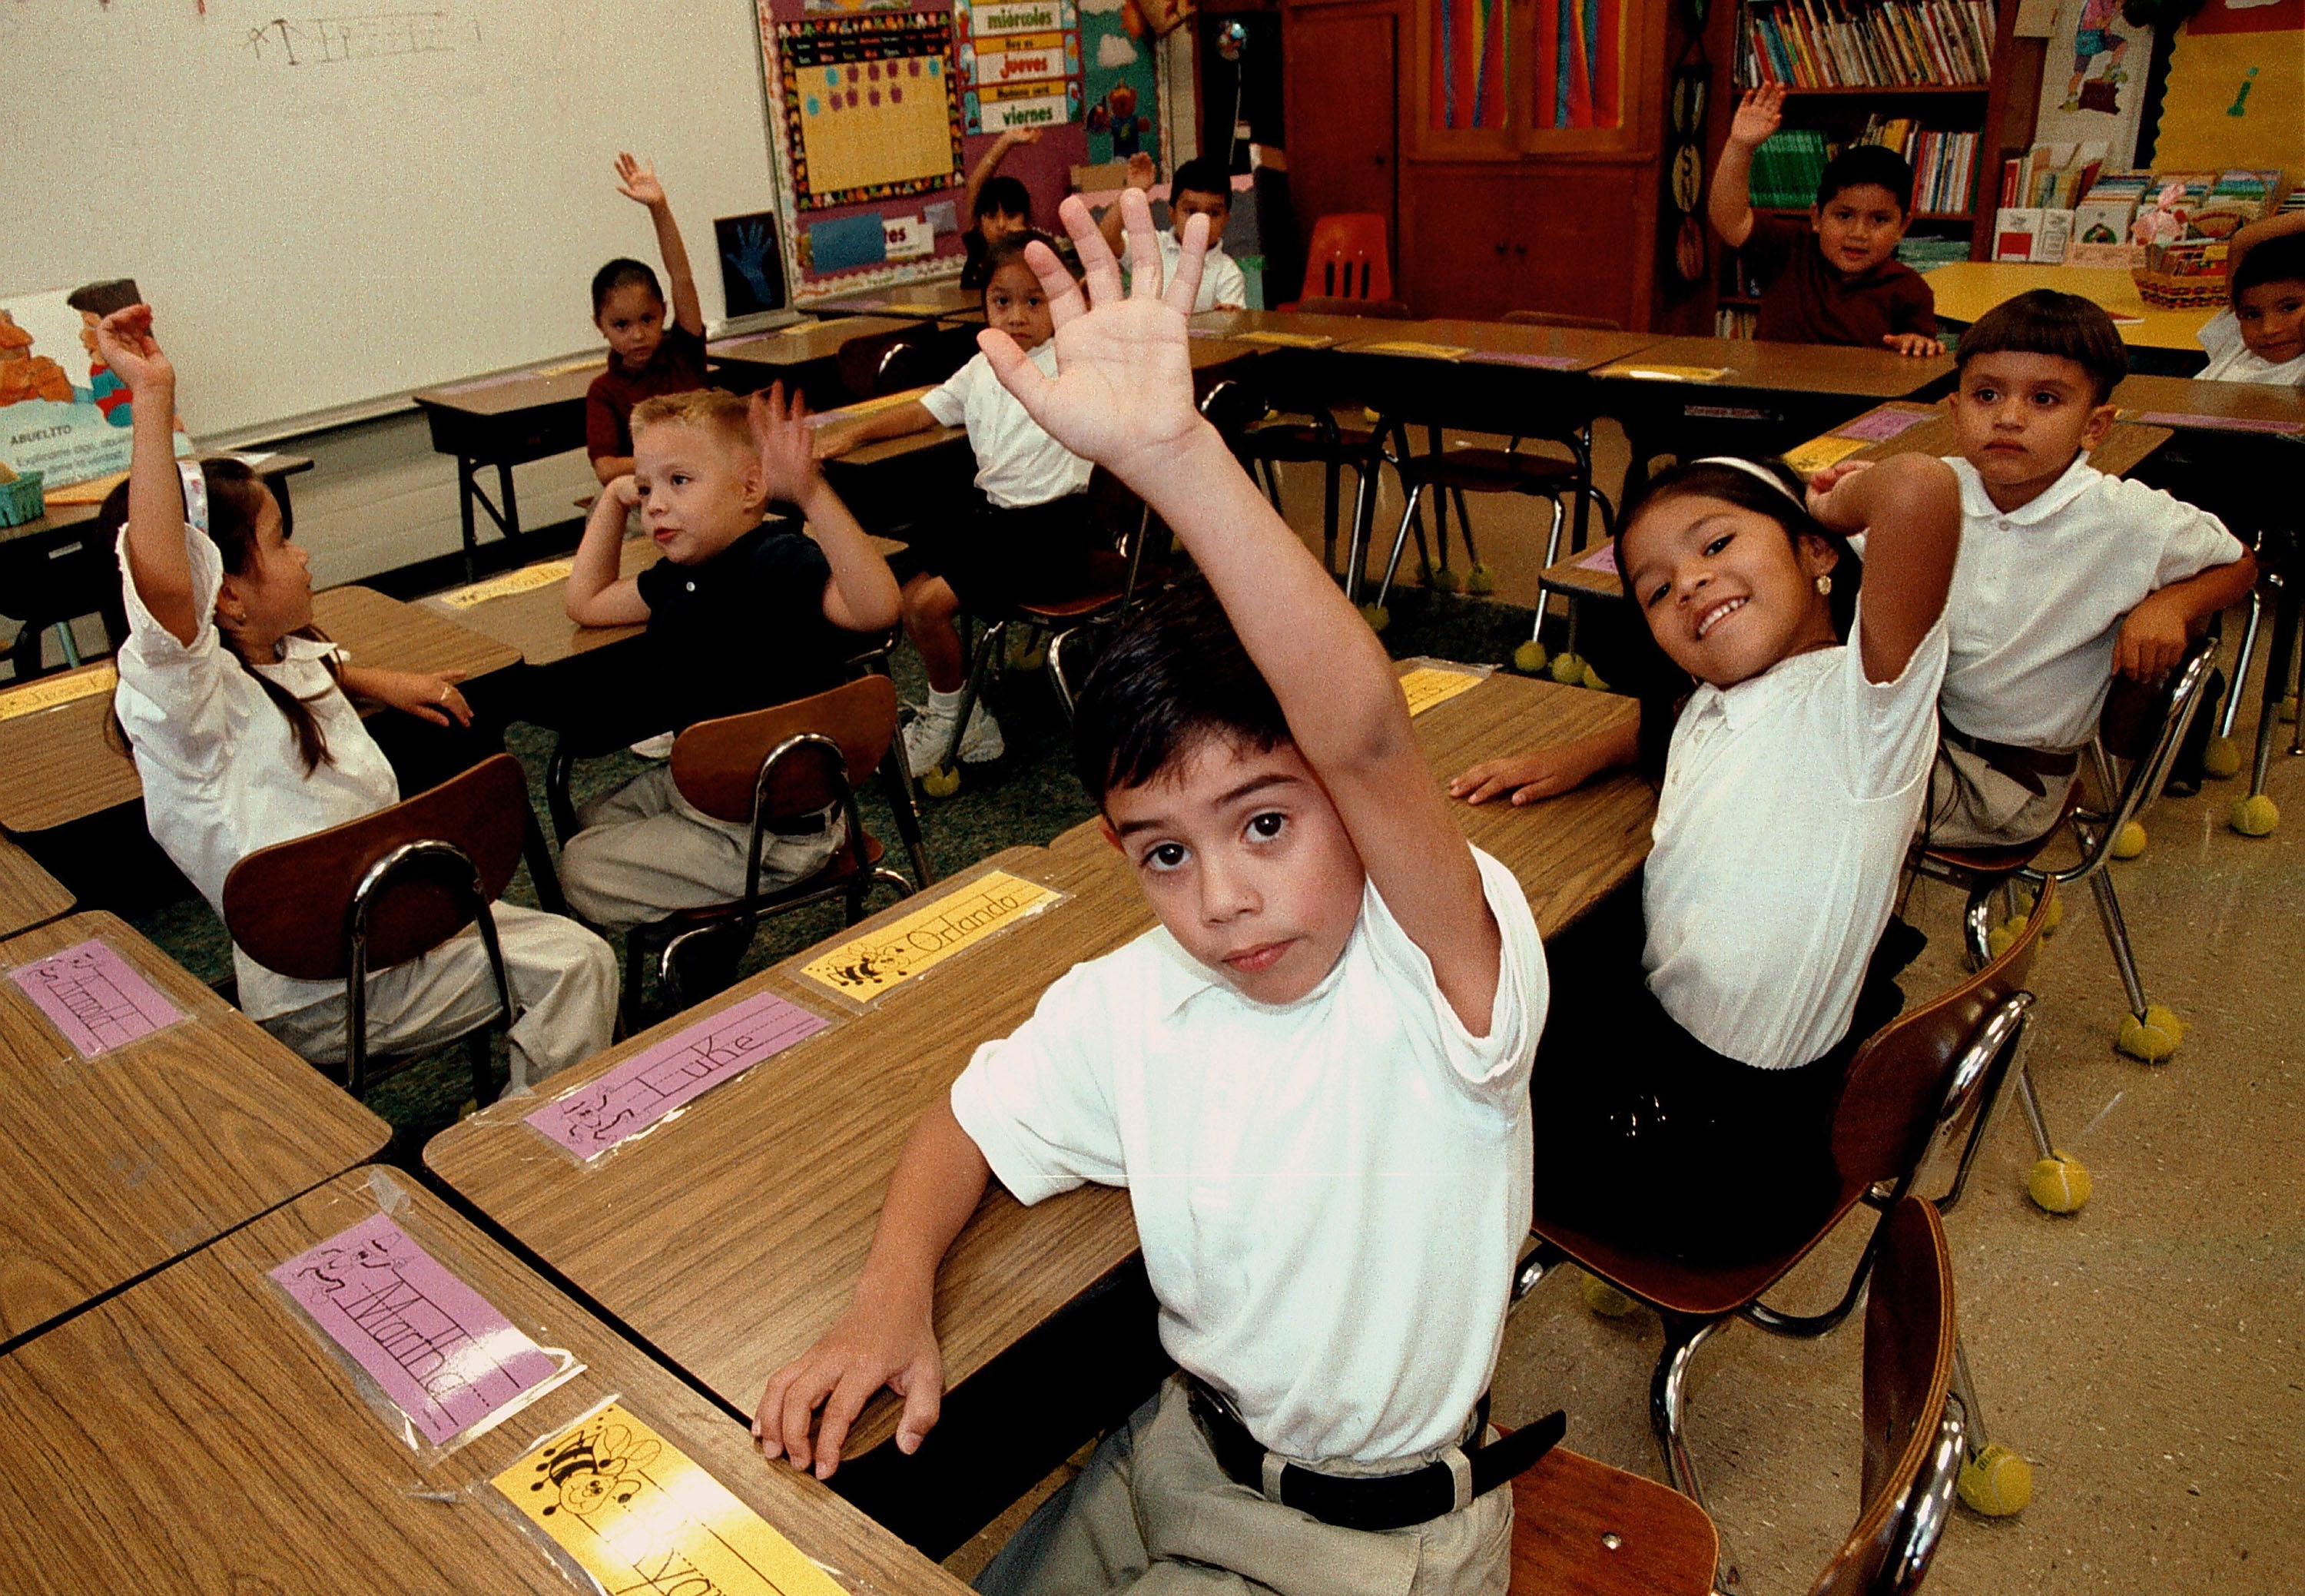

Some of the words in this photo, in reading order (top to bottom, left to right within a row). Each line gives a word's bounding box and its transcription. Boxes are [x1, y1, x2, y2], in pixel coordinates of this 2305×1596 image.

[988, 6, 1053, 28] miércoles
[1000, 53, 1048, 78] jueves
[1003, 105, 1053, 125] viernes
[11, 424, 72, 446] ABUELITO
[907, 893, 1019, 953] Orlando
[343, 1279, 466, 1399] Martha
